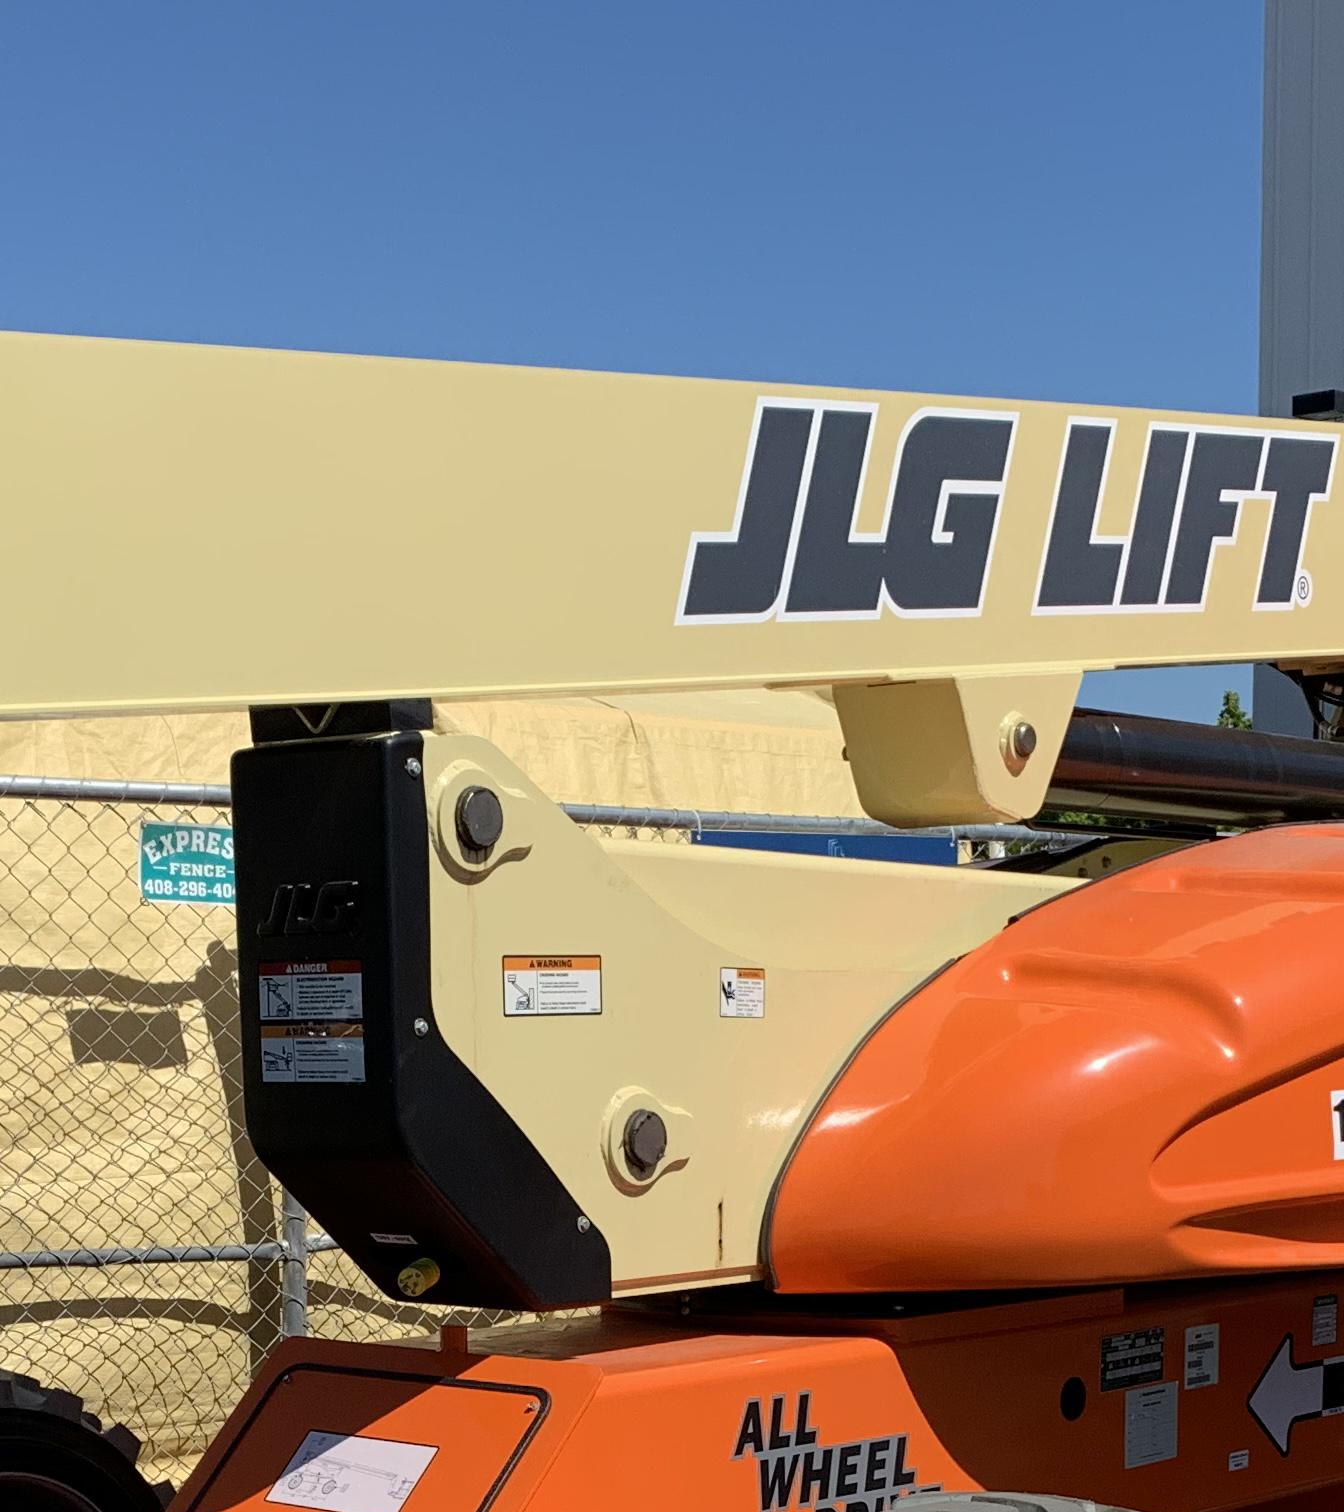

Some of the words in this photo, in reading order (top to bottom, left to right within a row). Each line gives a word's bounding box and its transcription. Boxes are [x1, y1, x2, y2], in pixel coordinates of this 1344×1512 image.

[675, 397, 1019, 625] JLG
[1033, 416, 1340, 615] LIFT
[169, 862, 226, 878] FENCE
[144, 879, 235, 898] 408-296-40
[293, 963, 328, 973] DANGER
[536, 960, 573, 968] WARNING
[733, 1392, 818, 1457] ALL
[758, 1436, 916, 1512] WHEEL
